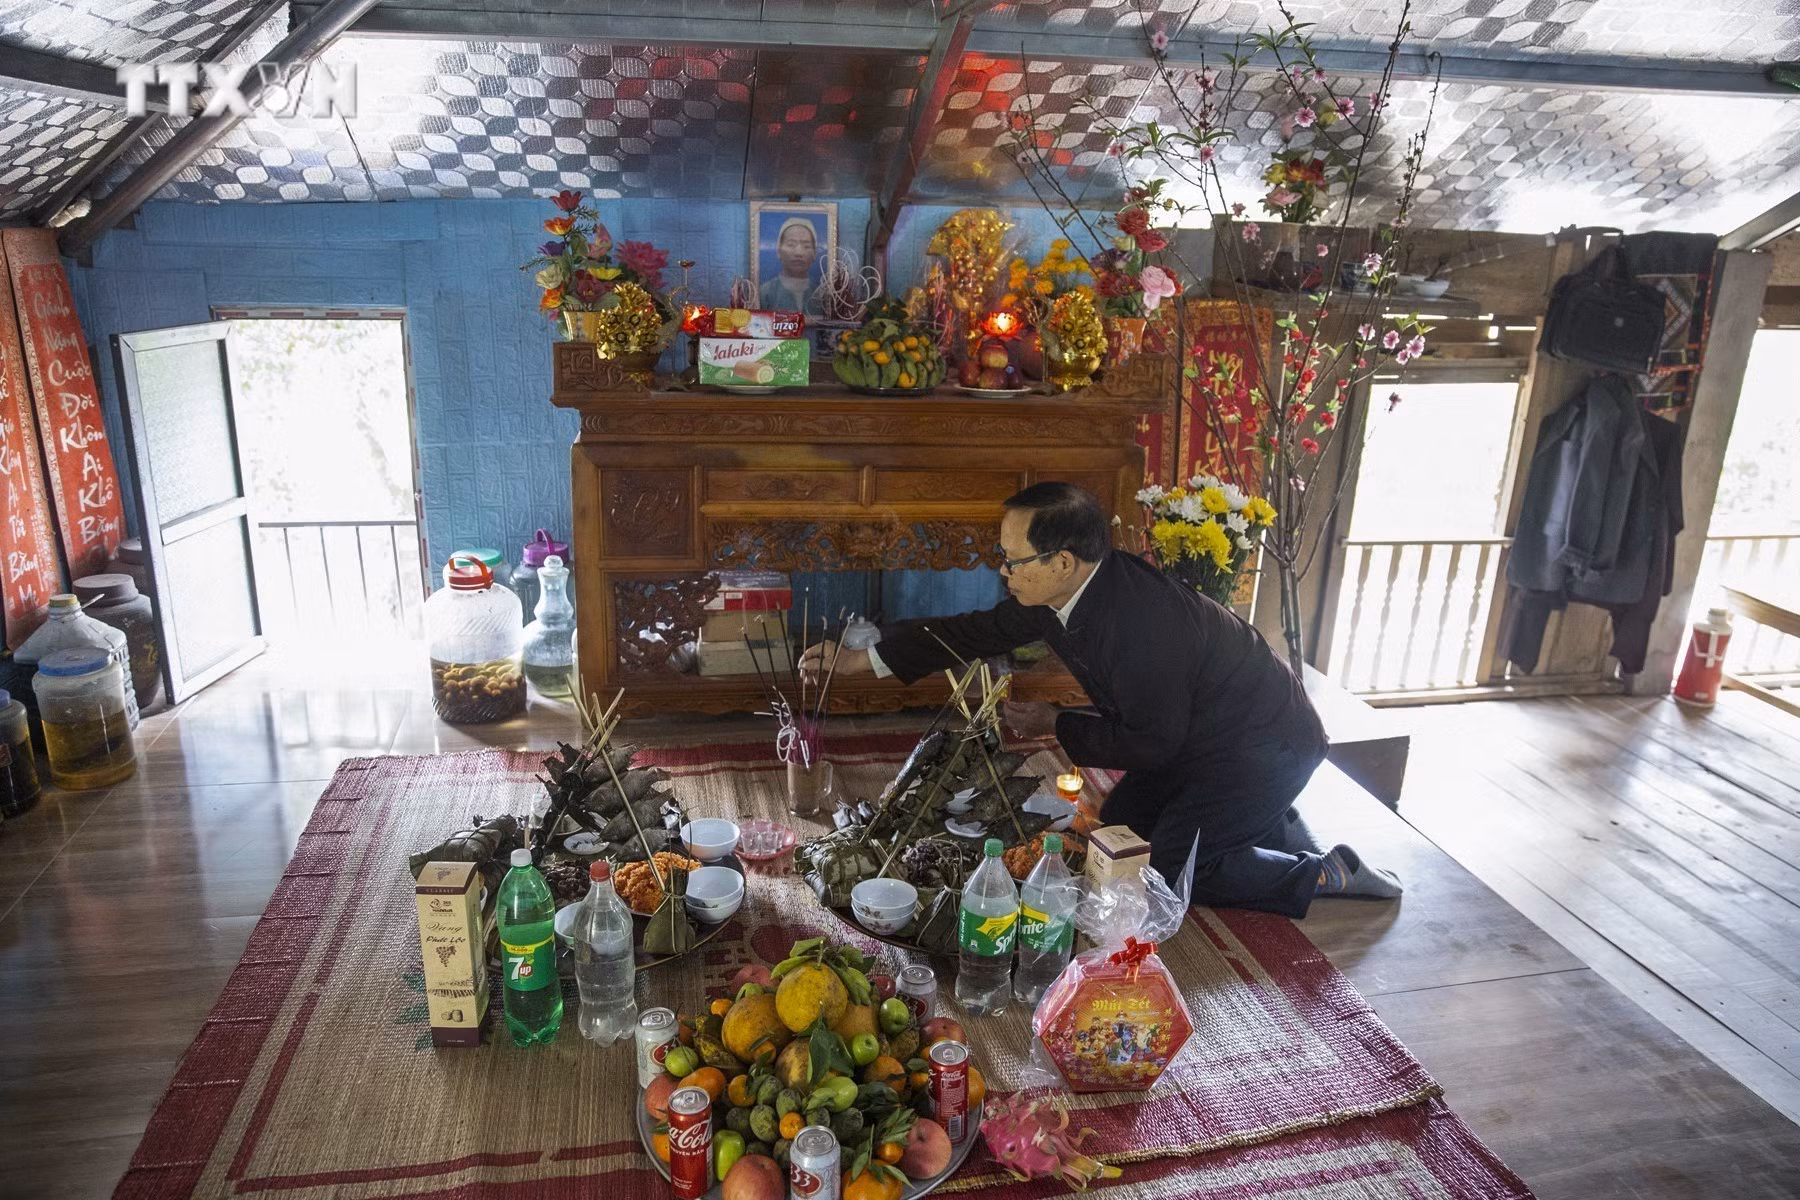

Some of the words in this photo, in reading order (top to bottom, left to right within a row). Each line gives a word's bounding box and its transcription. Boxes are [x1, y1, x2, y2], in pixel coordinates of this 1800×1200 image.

[47, 360, 92, 387] Cuộc
[58, 392, 95, 419] Đời
[60, 415, 106, 453] Khôn
[82, 451, 104, 481] Ai
[8, 479, 20, 512] Ai
[78, 474, 114, 513] Khổ
[77, 514, 120, 546] Bằng
[8, 551, 44, 592] Bằng
